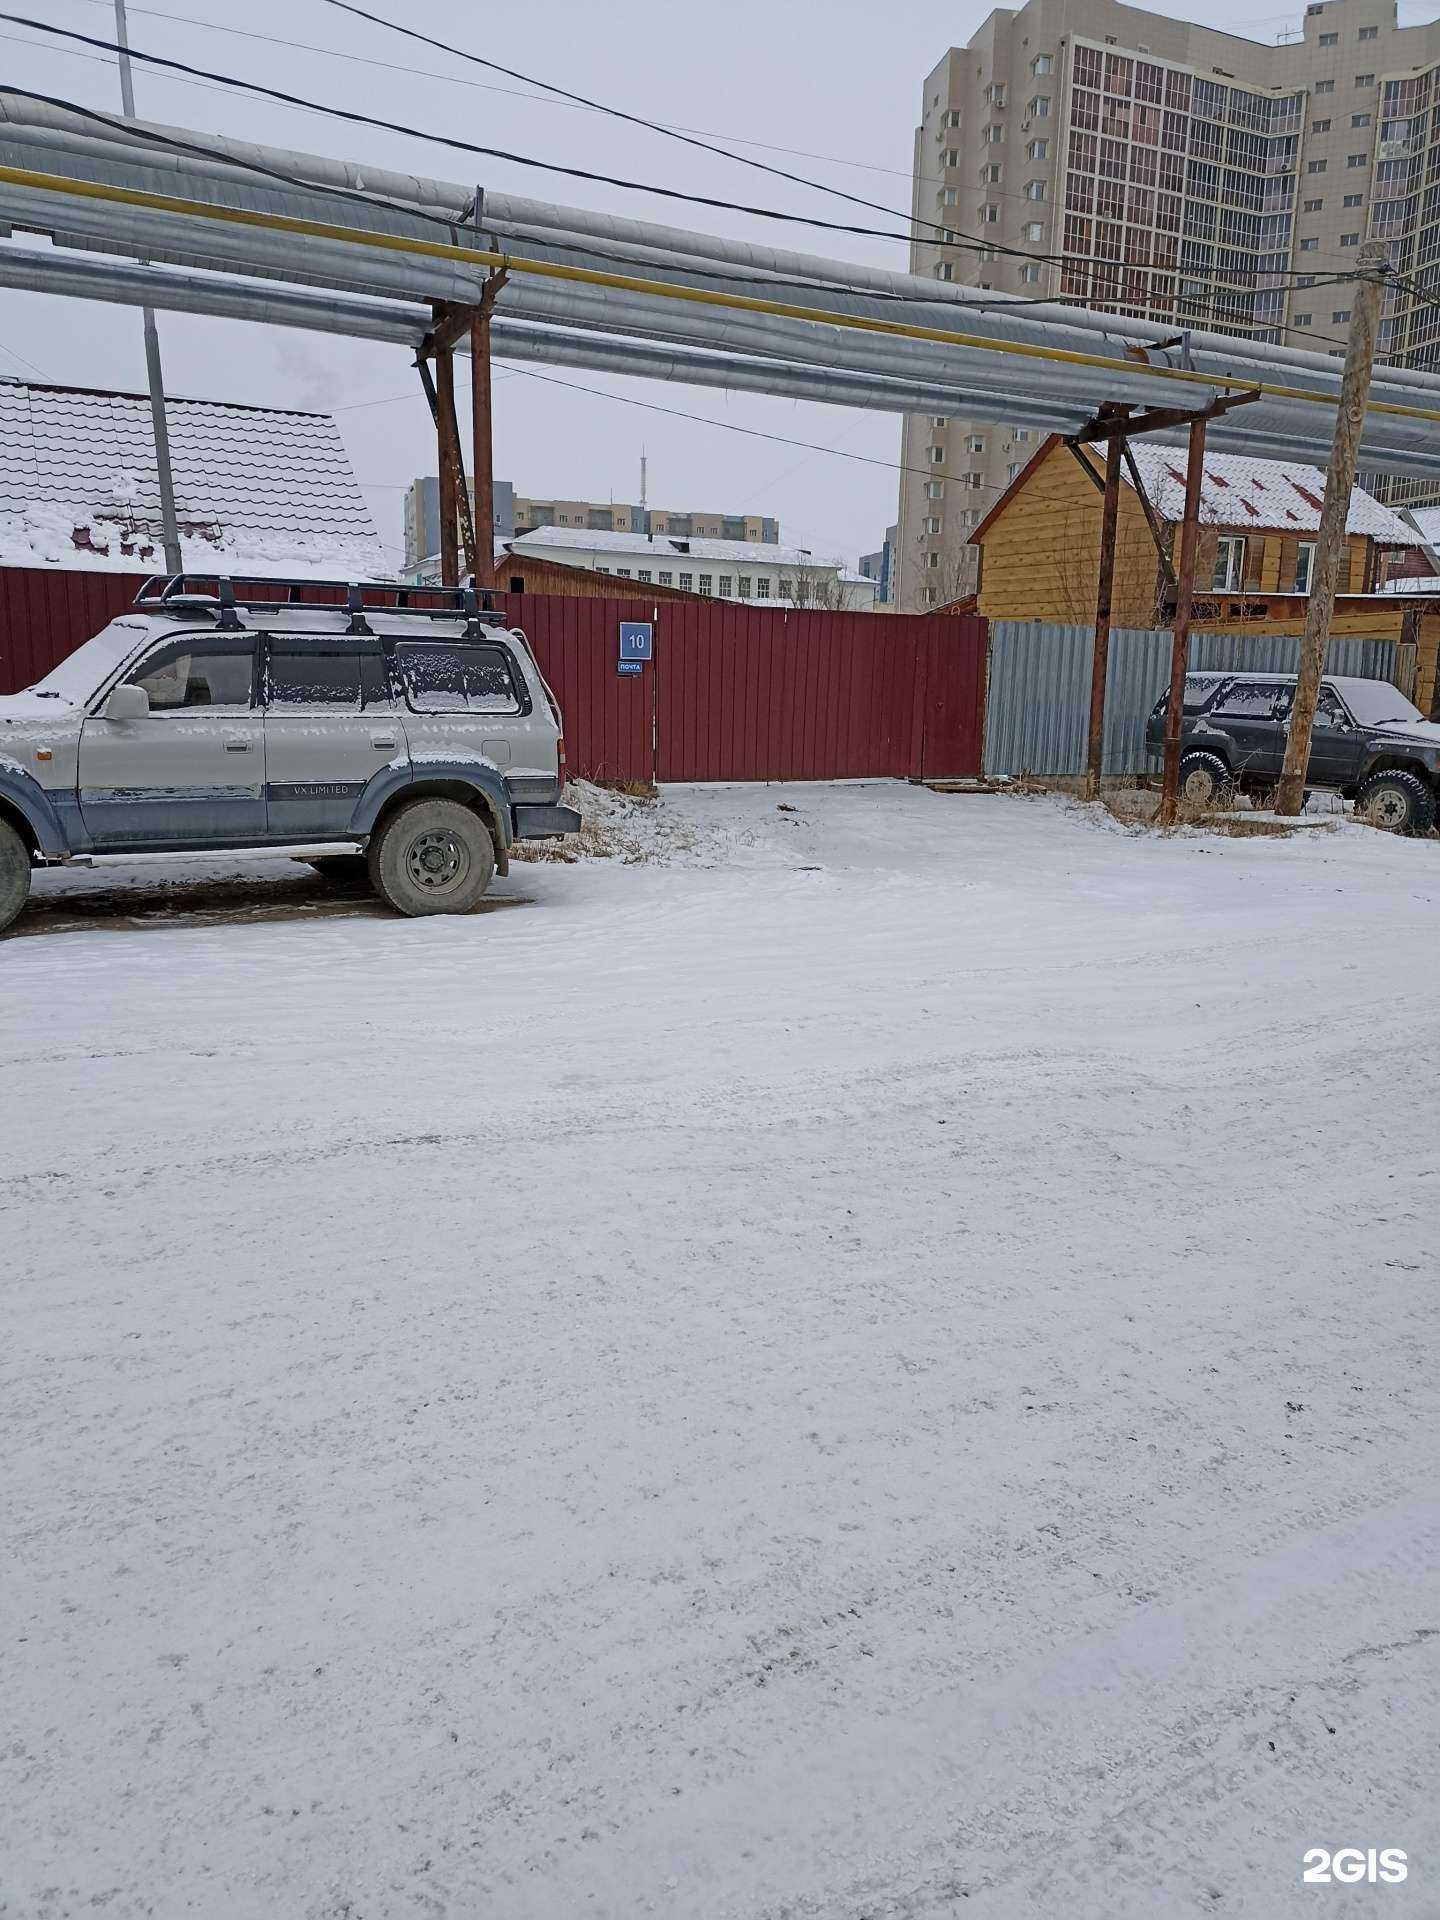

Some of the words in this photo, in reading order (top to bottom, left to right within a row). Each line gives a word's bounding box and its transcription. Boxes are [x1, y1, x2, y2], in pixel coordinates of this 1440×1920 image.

[629, 634, 644, 649] 10
[294, 786, 307, 794] VX
[310, 785, 348, 794] LIMITED
